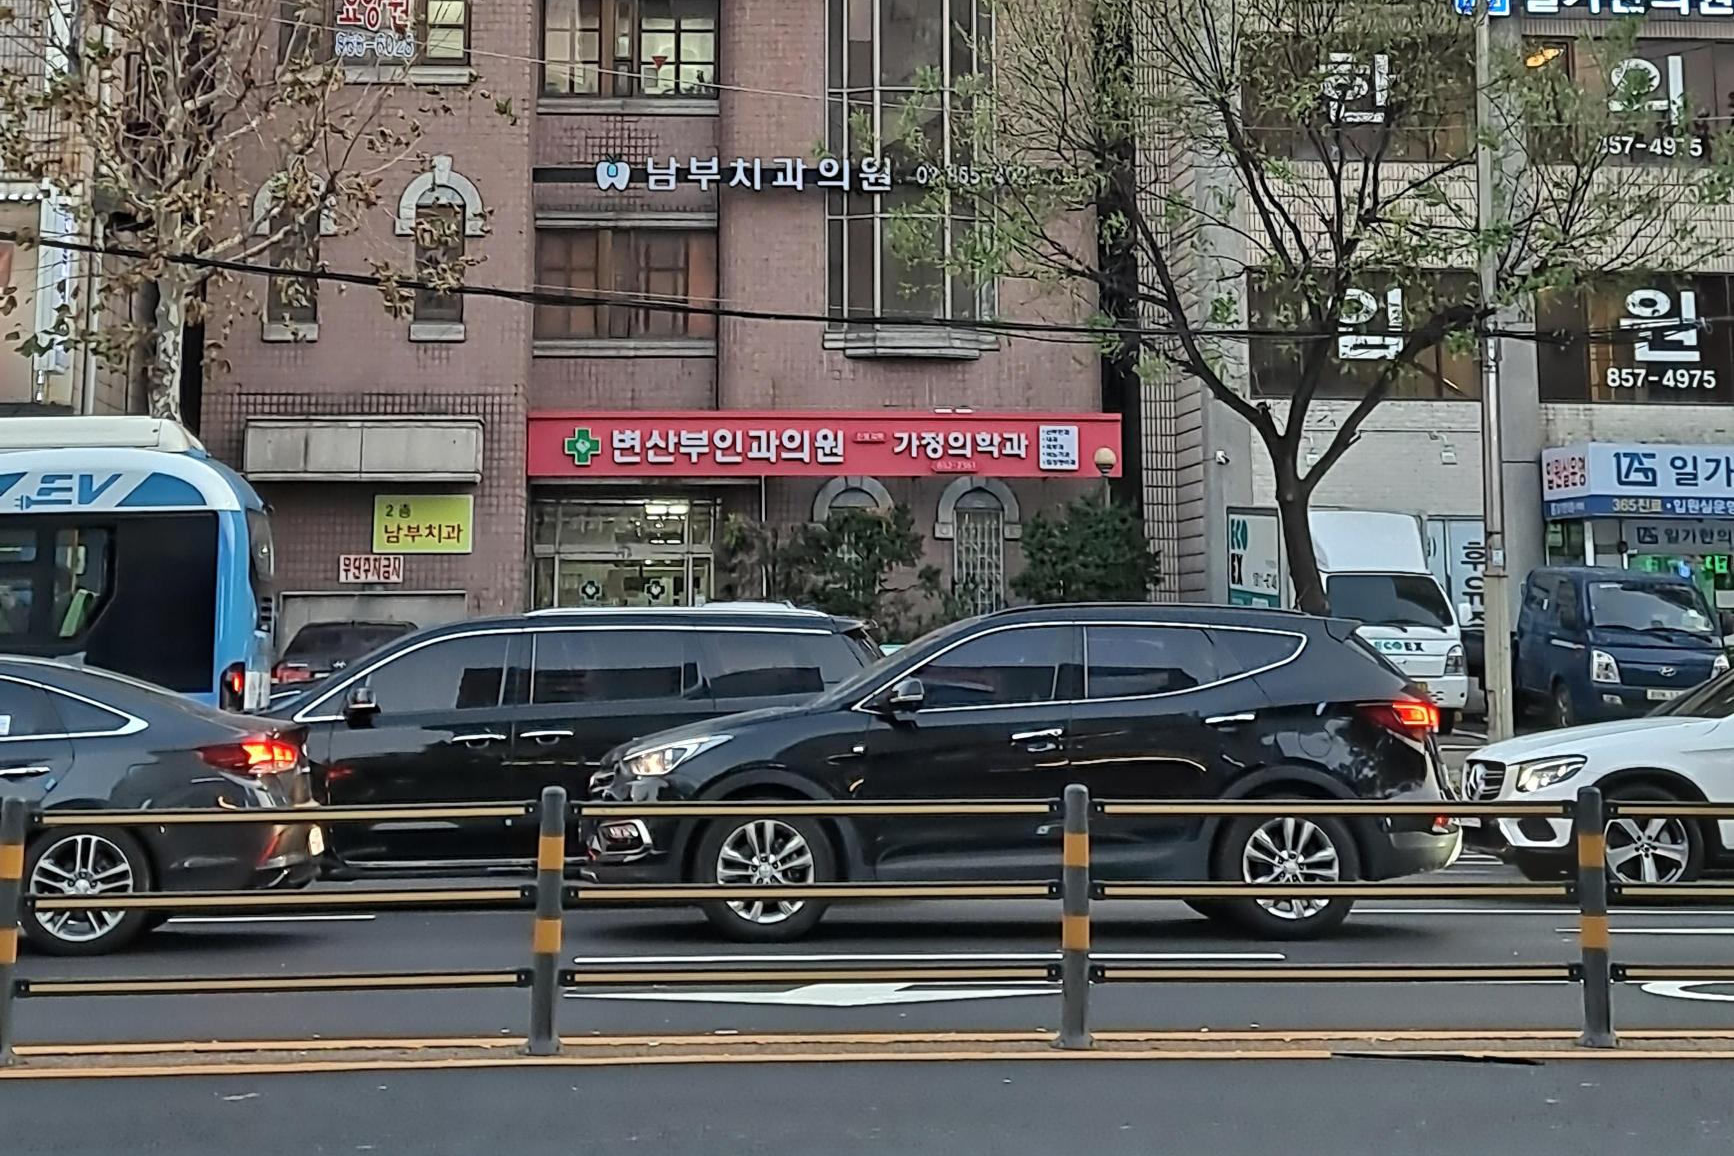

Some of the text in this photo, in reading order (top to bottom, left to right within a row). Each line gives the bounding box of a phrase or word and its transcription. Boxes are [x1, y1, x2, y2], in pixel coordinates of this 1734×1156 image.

[1318, 52, 1397, 124] 한
[646, 156, 892, 192] 남부치과의원
[1619, 289, 1700, 362] 원
[1607, 368, 1716, 388] 857-4975
[611, 428, 1028, 464] 변산부인과의원 가정의학과
[1669, 455, 1734, 488] 일가
[27, 473, 123, 506] EV
[384, 523, 463, 544] 남부치과
